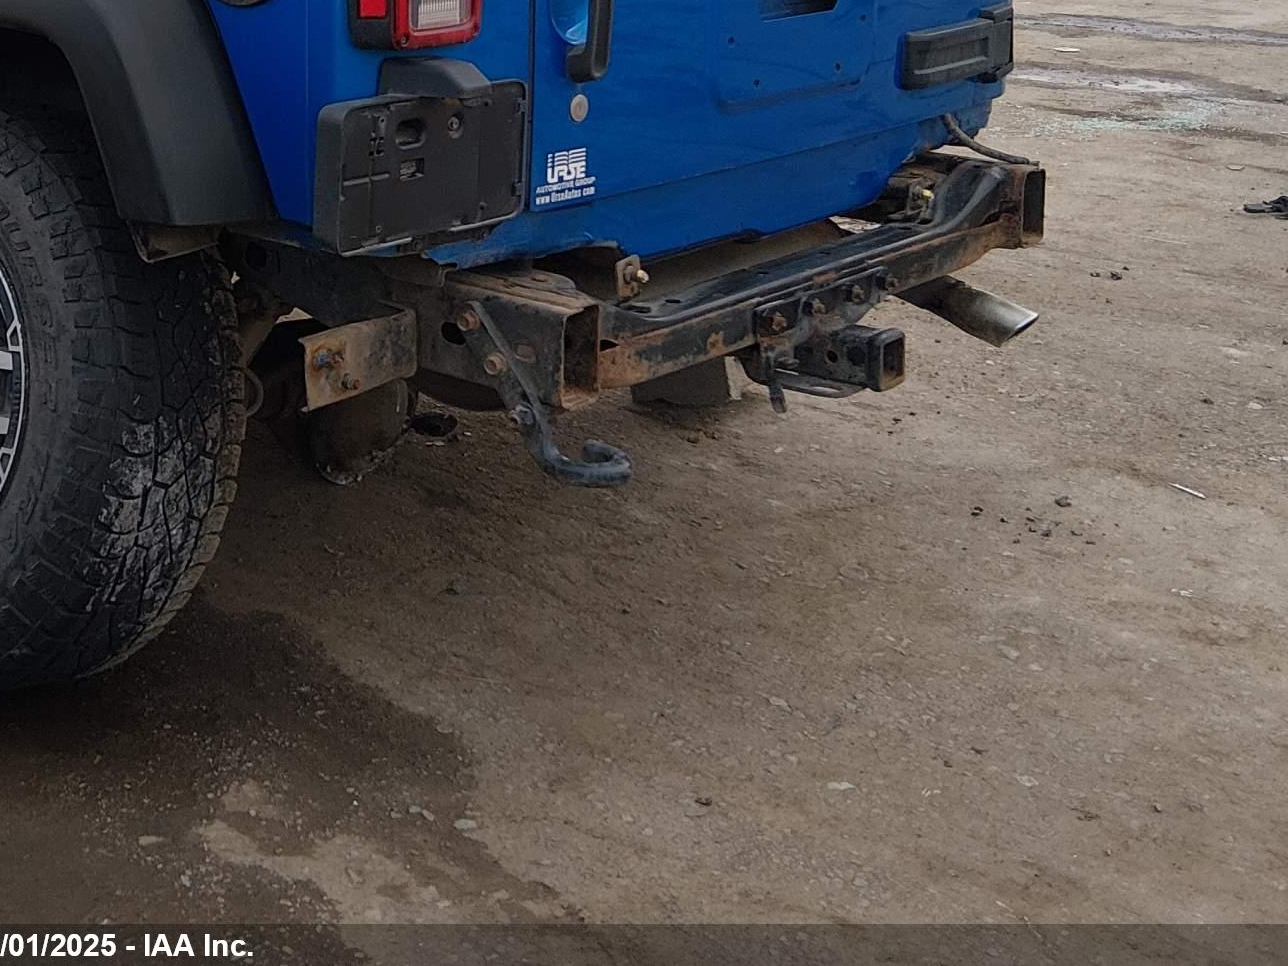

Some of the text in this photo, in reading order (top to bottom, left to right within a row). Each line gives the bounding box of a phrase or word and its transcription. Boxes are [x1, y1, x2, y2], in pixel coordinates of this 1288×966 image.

[535, 176, 596, 194] AUTOMOTIVE GROUP
[535, 186, 595, 205] wwwUrseAutoscom
